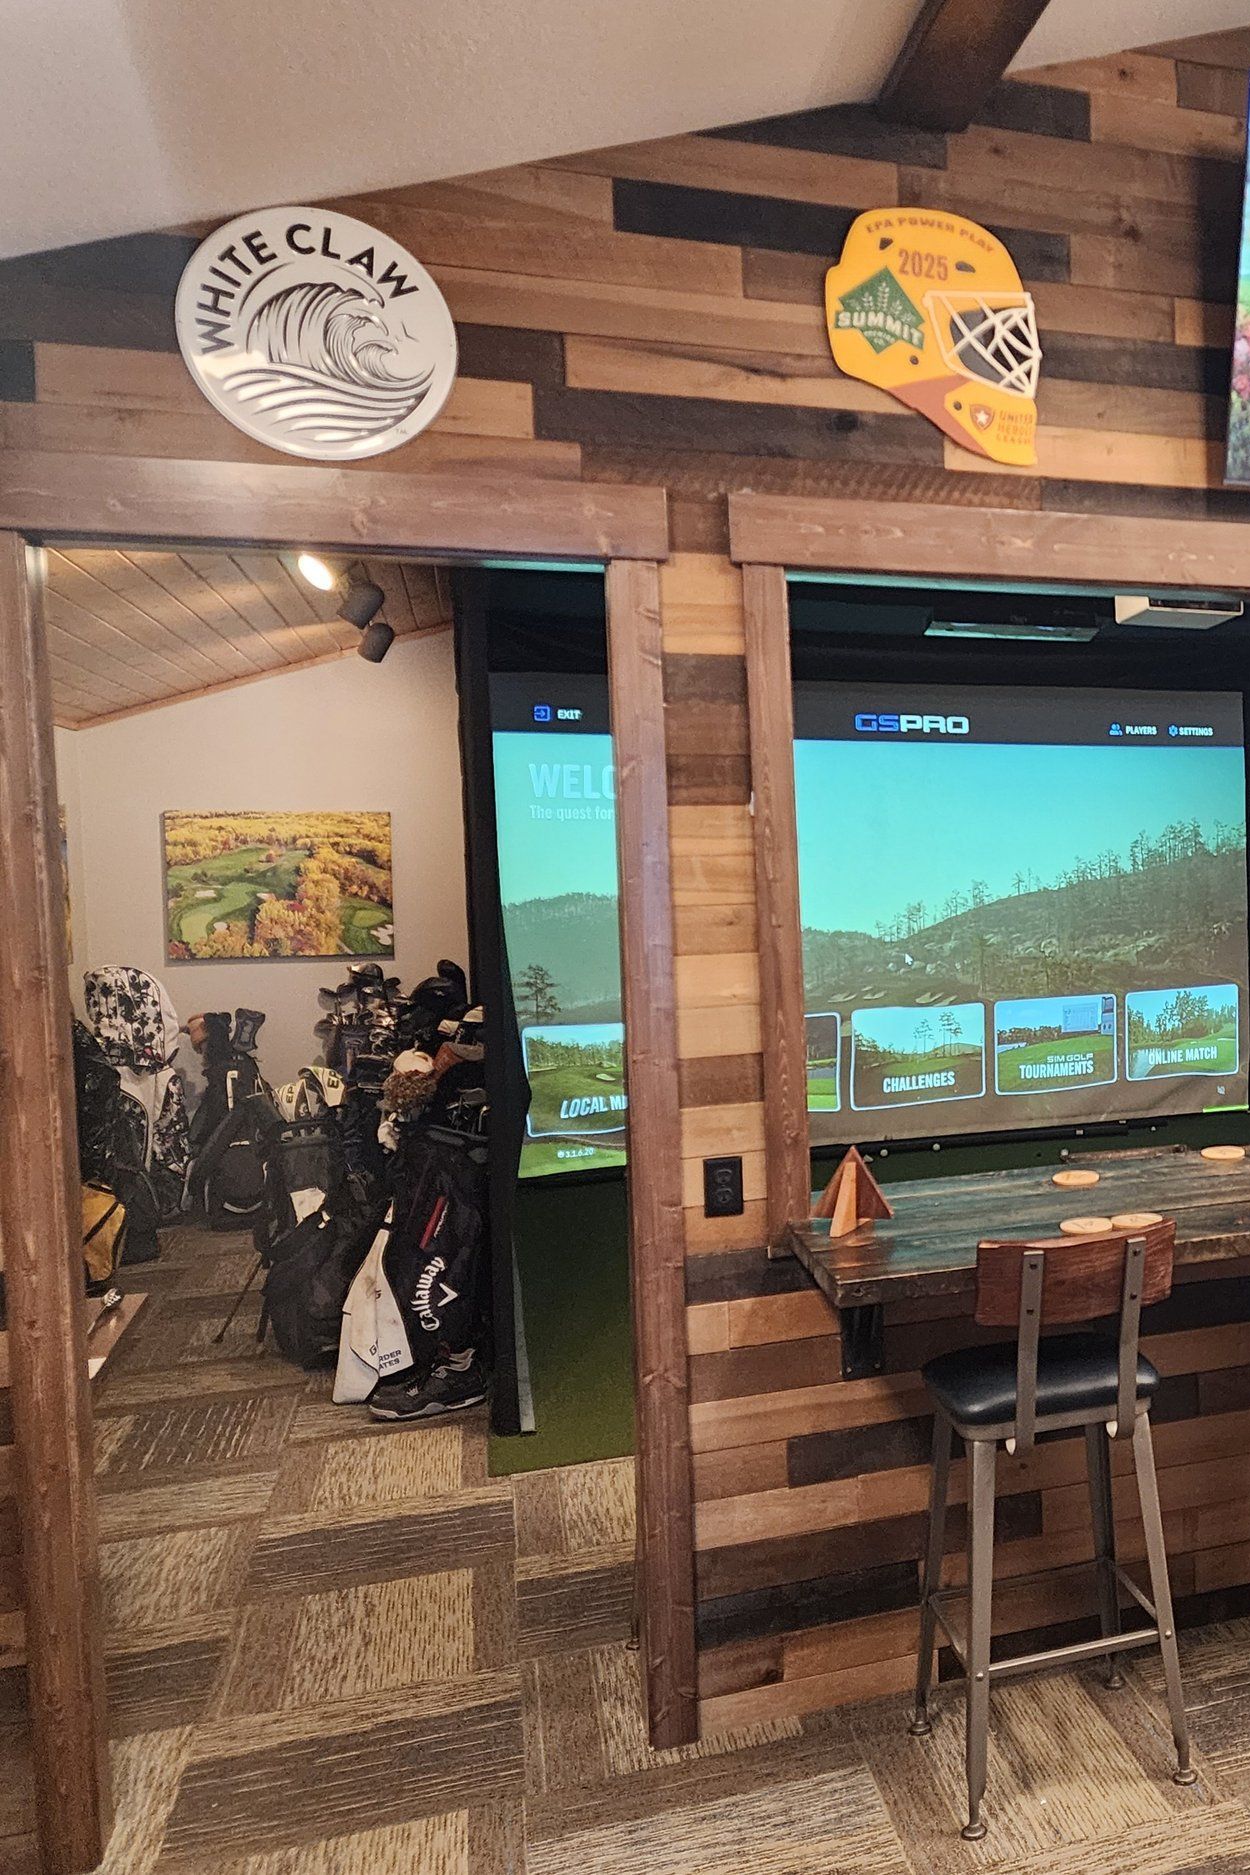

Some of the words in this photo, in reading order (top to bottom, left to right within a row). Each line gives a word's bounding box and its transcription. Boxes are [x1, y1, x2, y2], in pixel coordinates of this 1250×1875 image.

[897, 217, 955, 233] POWER
[960, 228, 994, 252] PLAY
[899, 249, 948, 281] 2025
[195, 229, 277, 354] WHITE
[285, 223, 420, 300] CLAW
[837, 311, 923, 346] SUMMIT
[557, 708, 582, 721] EXIT
[854, 713, 970, 734] GSPRO
[1125, 724, 1157, 736] PLAYERS
[1178, 725, 1214, 737] SETTINGS
[529, 805, 553, 820] The
[556, 806, 592, 822] quest
[1047, 1055, 1065, 1063] SIM
[1066, 1053, 1093, 1061] GOLF
[1148, 1049, 1183, 1065] ONLINE
[1185, 1046, 1217, 1061] MATCH
[1019, 1060, 1094, 1080] TOURNAMENTS
[883, 1071, 956, 1093] CHALLENGES
[560, 1096, 608, 1119] LOCAL
[410, 1256, 445, 1331] Callaway
